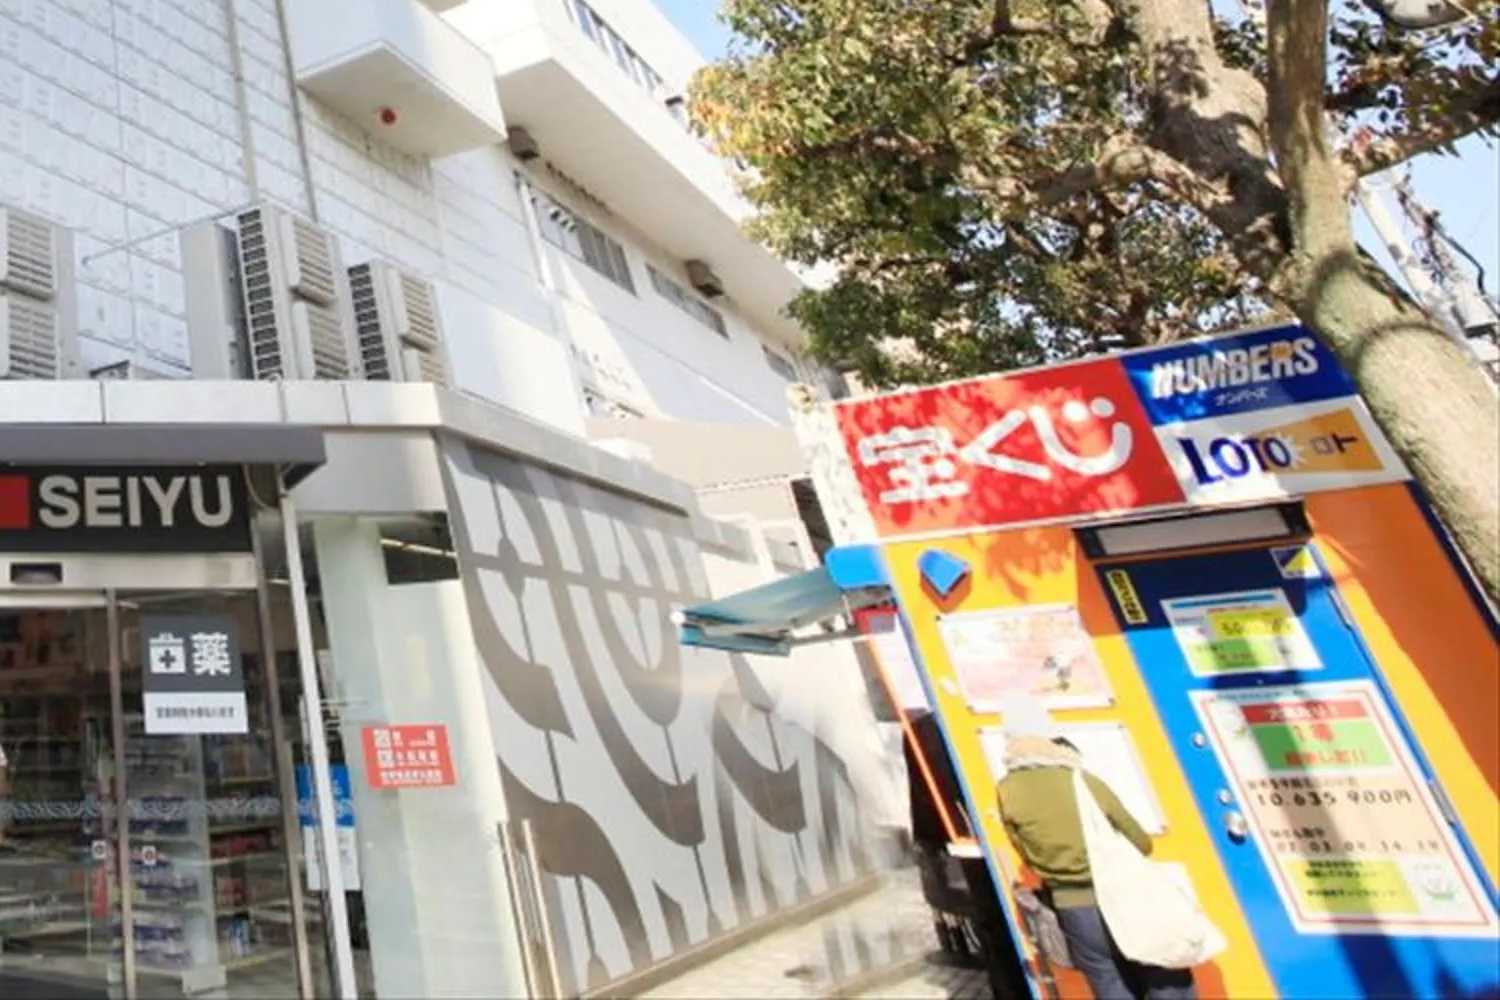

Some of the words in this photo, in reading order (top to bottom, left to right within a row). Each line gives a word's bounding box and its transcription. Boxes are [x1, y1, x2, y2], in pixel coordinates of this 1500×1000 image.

[1153, 338, 1319, 398] NUMBERS
[857, 397, 1133, 504] 宝くじ
[1177, 437, 1291, 485] LOTO
[38, 474, 233, 529] SEIYU
[190, 632, 232, 676] 薬
